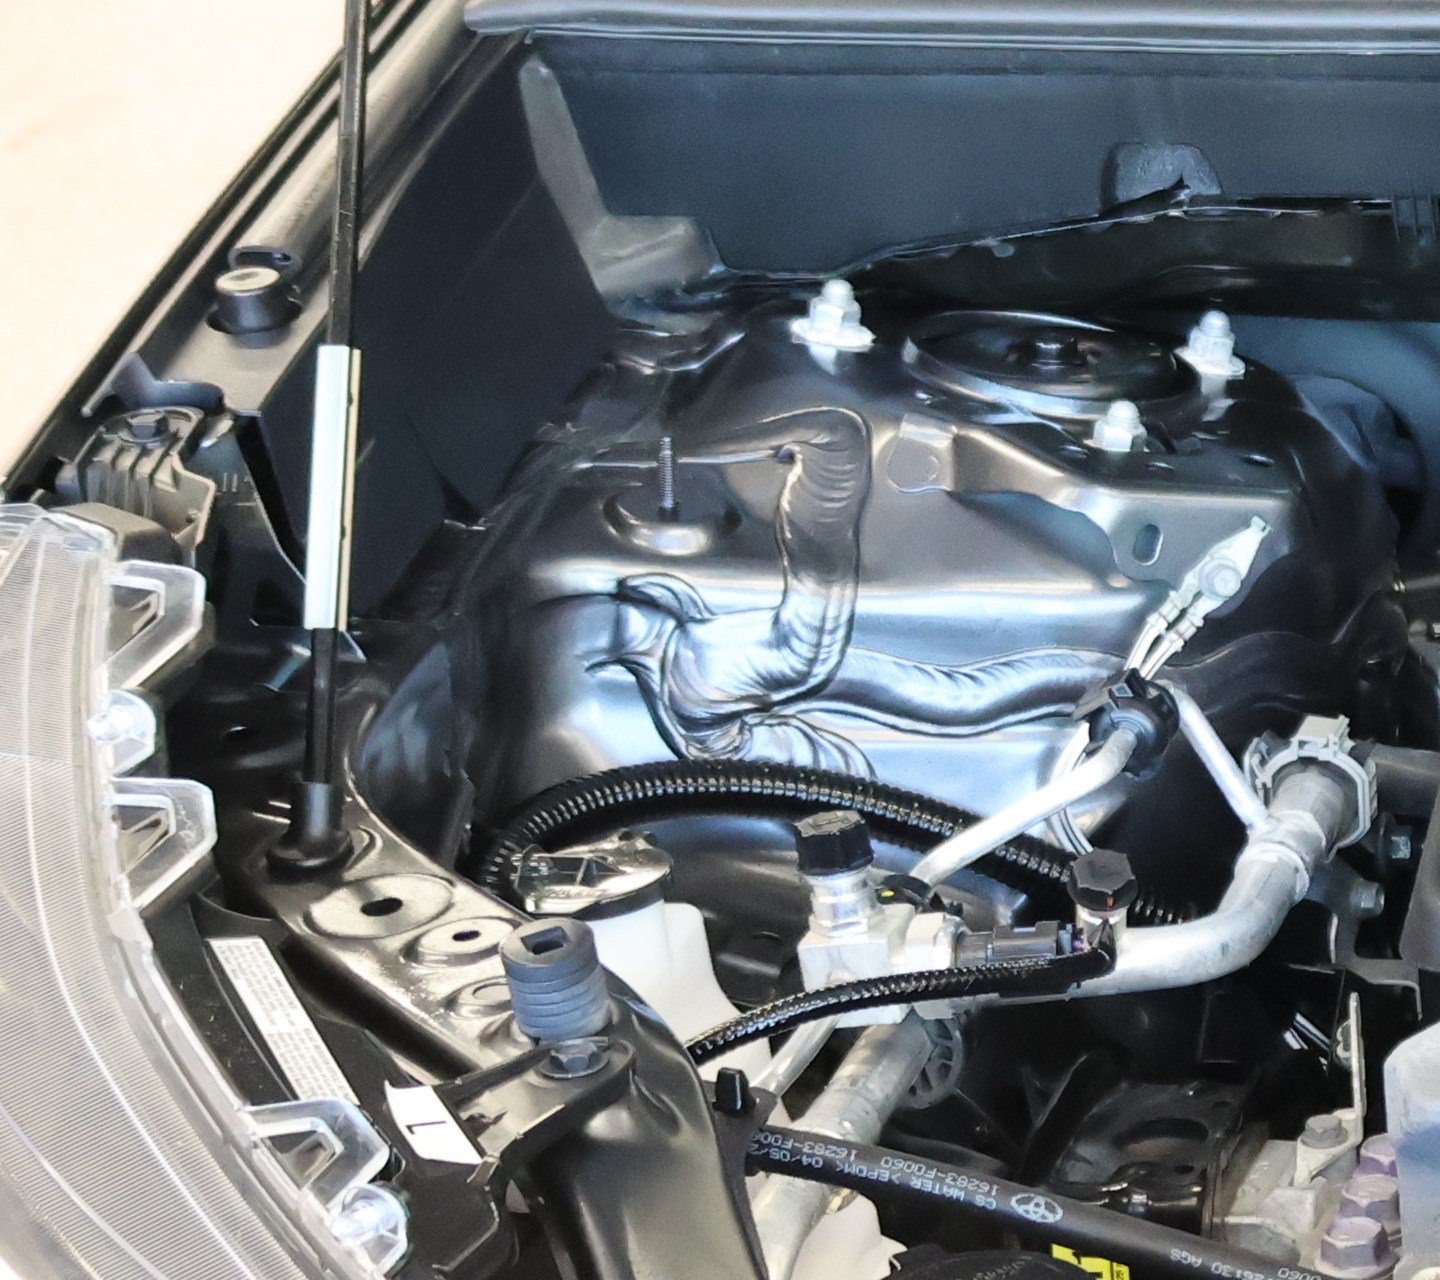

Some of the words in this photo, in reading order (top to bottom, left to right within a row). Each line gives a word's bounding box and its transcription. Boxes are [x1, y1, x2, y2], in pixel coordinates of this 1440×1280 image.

[880, 1156, 999, 1196] 16283-F0060
[911, 1176, 965, 1201] WATER
[1169, 1247, 1203, 1268] AGS
